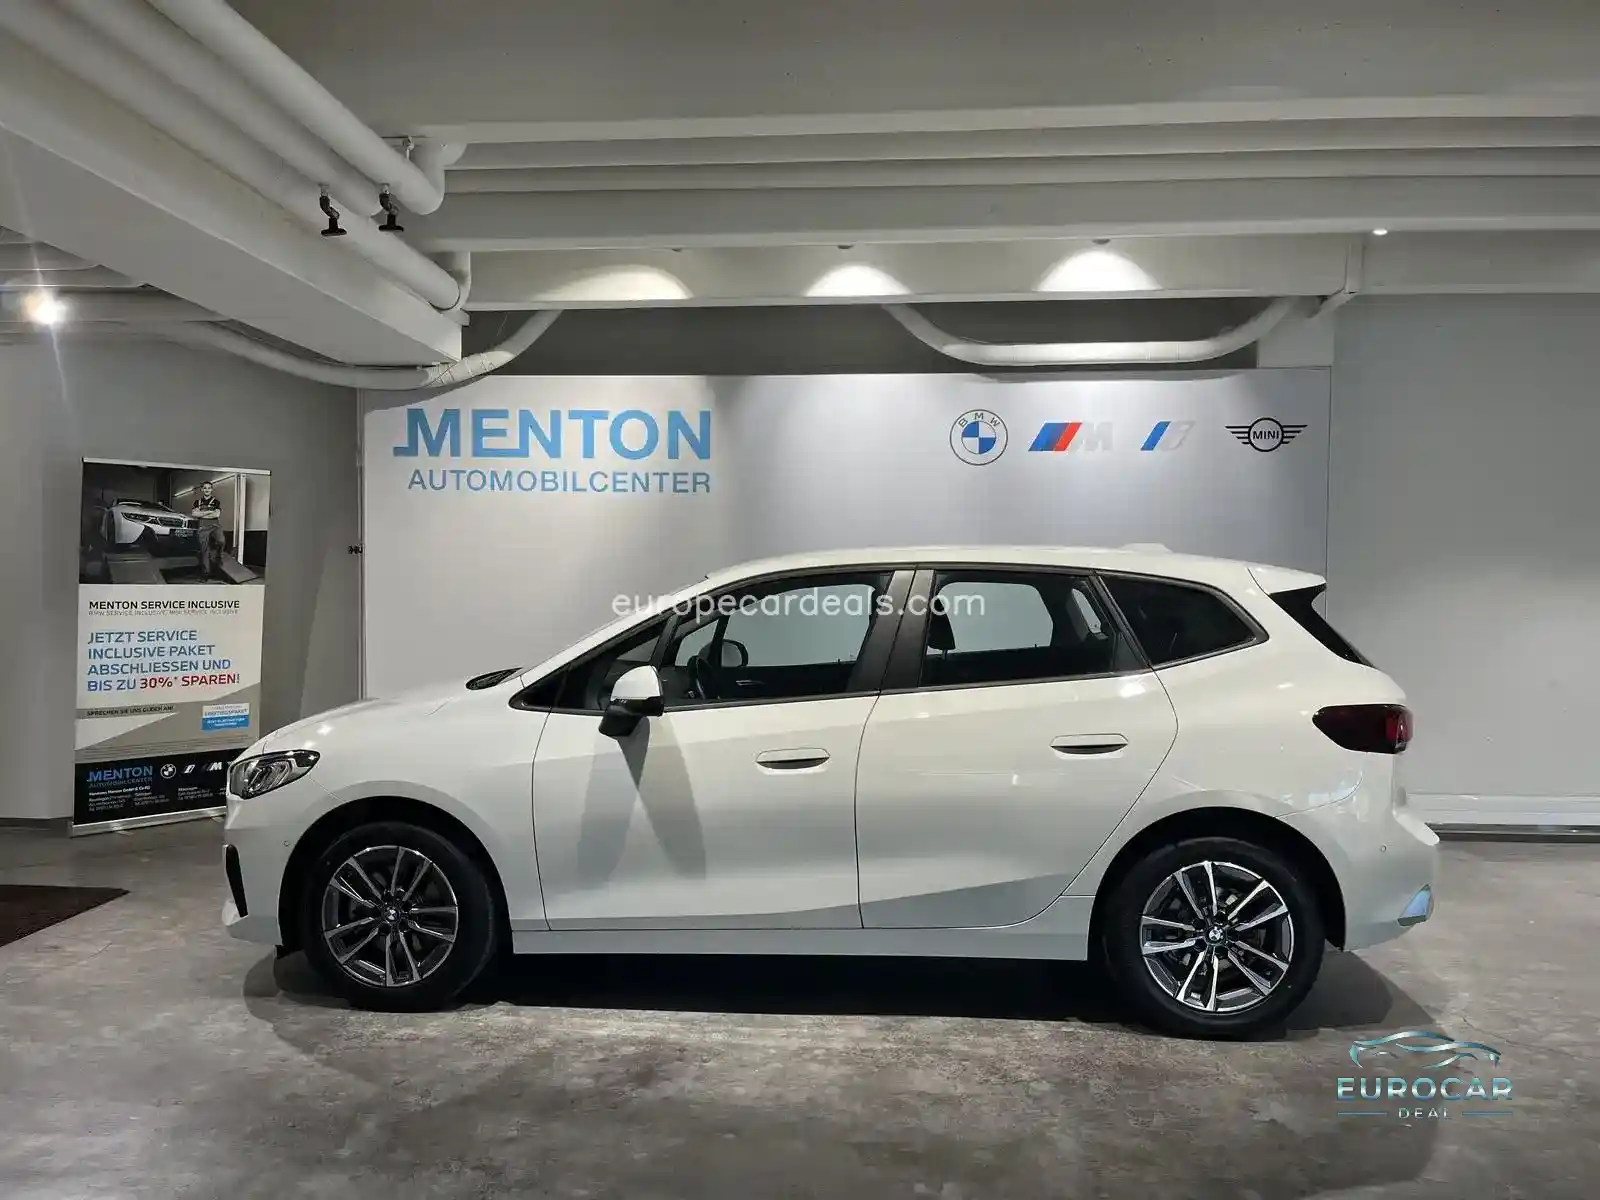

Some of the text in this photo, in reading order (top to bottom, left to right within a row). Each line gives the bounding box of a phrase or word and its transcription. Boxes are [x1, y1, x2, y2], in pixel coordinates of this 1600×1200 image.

[393, 408, 711, 460] MENTON
[1252, 430, 1280, 441] MINI
[408, 469, 711, 494] AUTOMOBILCENTER
[88, 600, 240, 610] MENTON SERVICE INCLUSIVE
[88, 630, 197, 644] JETZT SERVICE
[88, 645, 215, 660] INCLUSIVE PAKET
[87, 659, 231, 676] ABSCHLIESSEN UND
[87, 680, 113, 692] BIS
[116, 679, 136, 691] ZU
[181, 674, 240, 687] SPAREN!
[87, 766, 153, 782] MENTON
